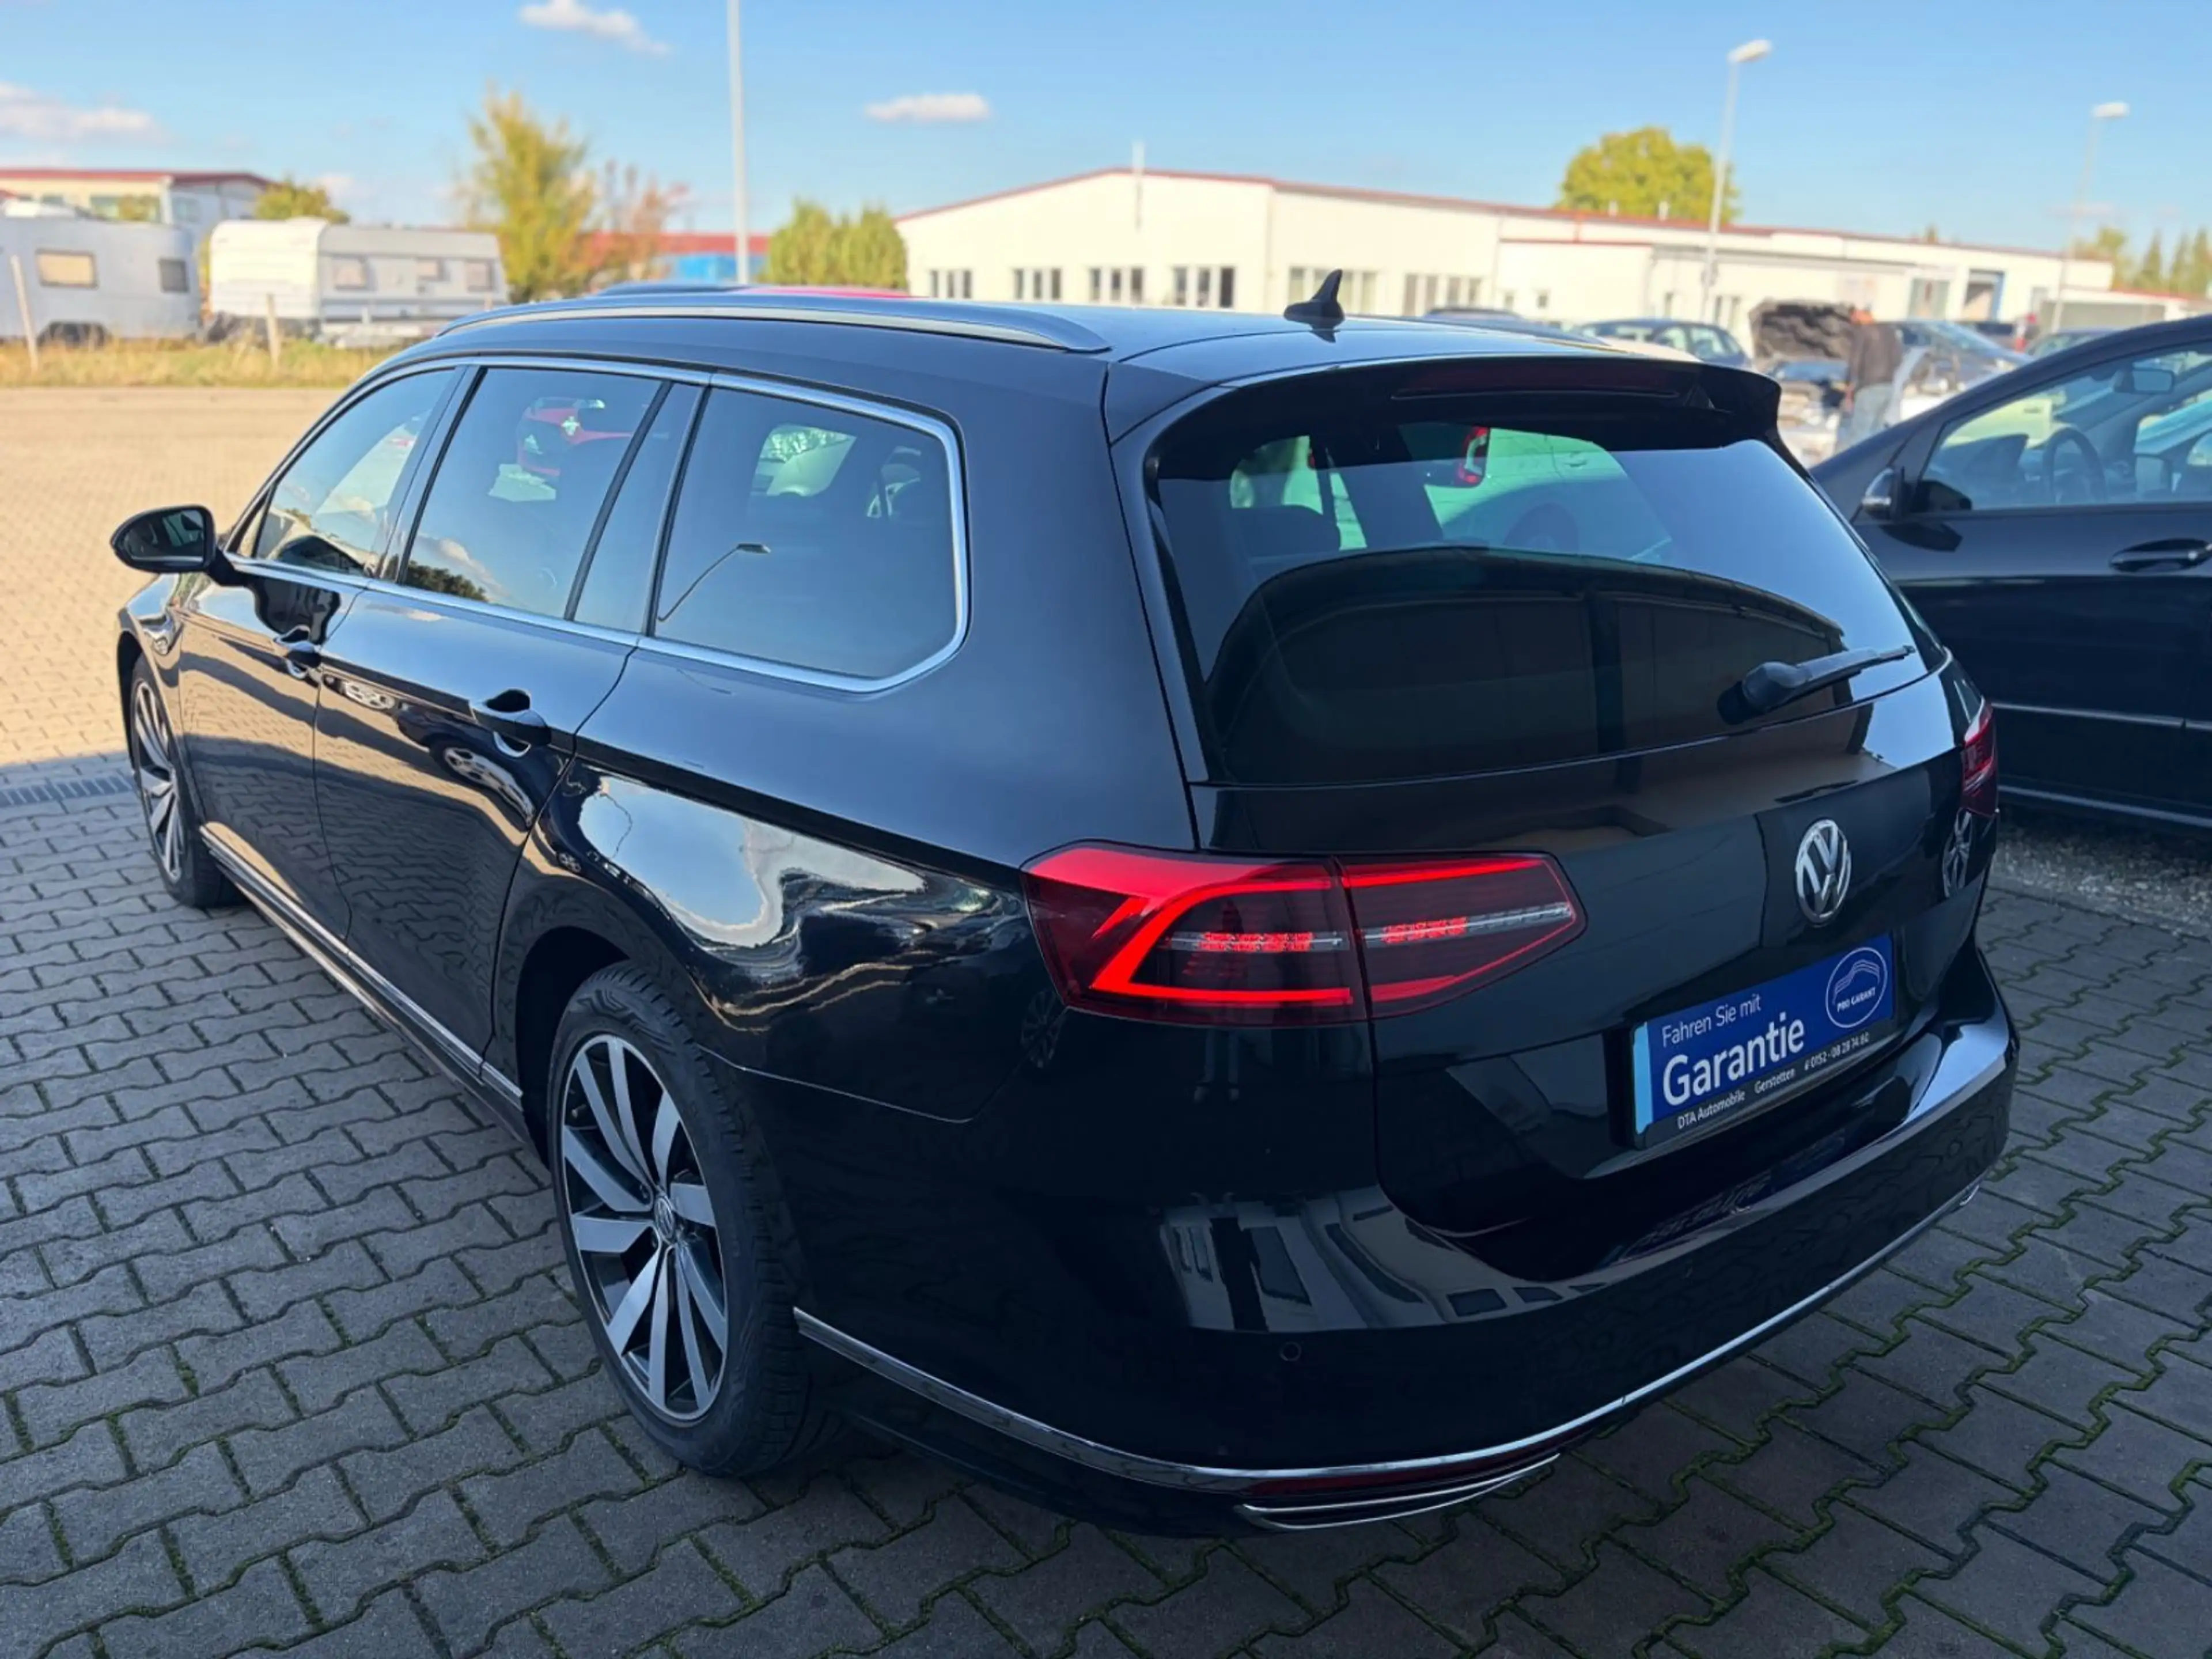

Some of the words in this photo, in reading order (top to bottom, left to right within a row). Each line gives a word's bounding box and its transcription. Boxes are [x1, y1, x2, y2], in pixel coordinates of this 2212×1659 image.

[1661, 1016, 1712, 1048] Fahren
[1715, 1003, 1737, 1027] Sie
[1740, 993, 1762, 1018] mit
[1662, 1011, 1805, 1107] Garantie
[1677, 1111, 1697, 1130] DTA
[1697, 1089, 1746, 1121] Automobile
